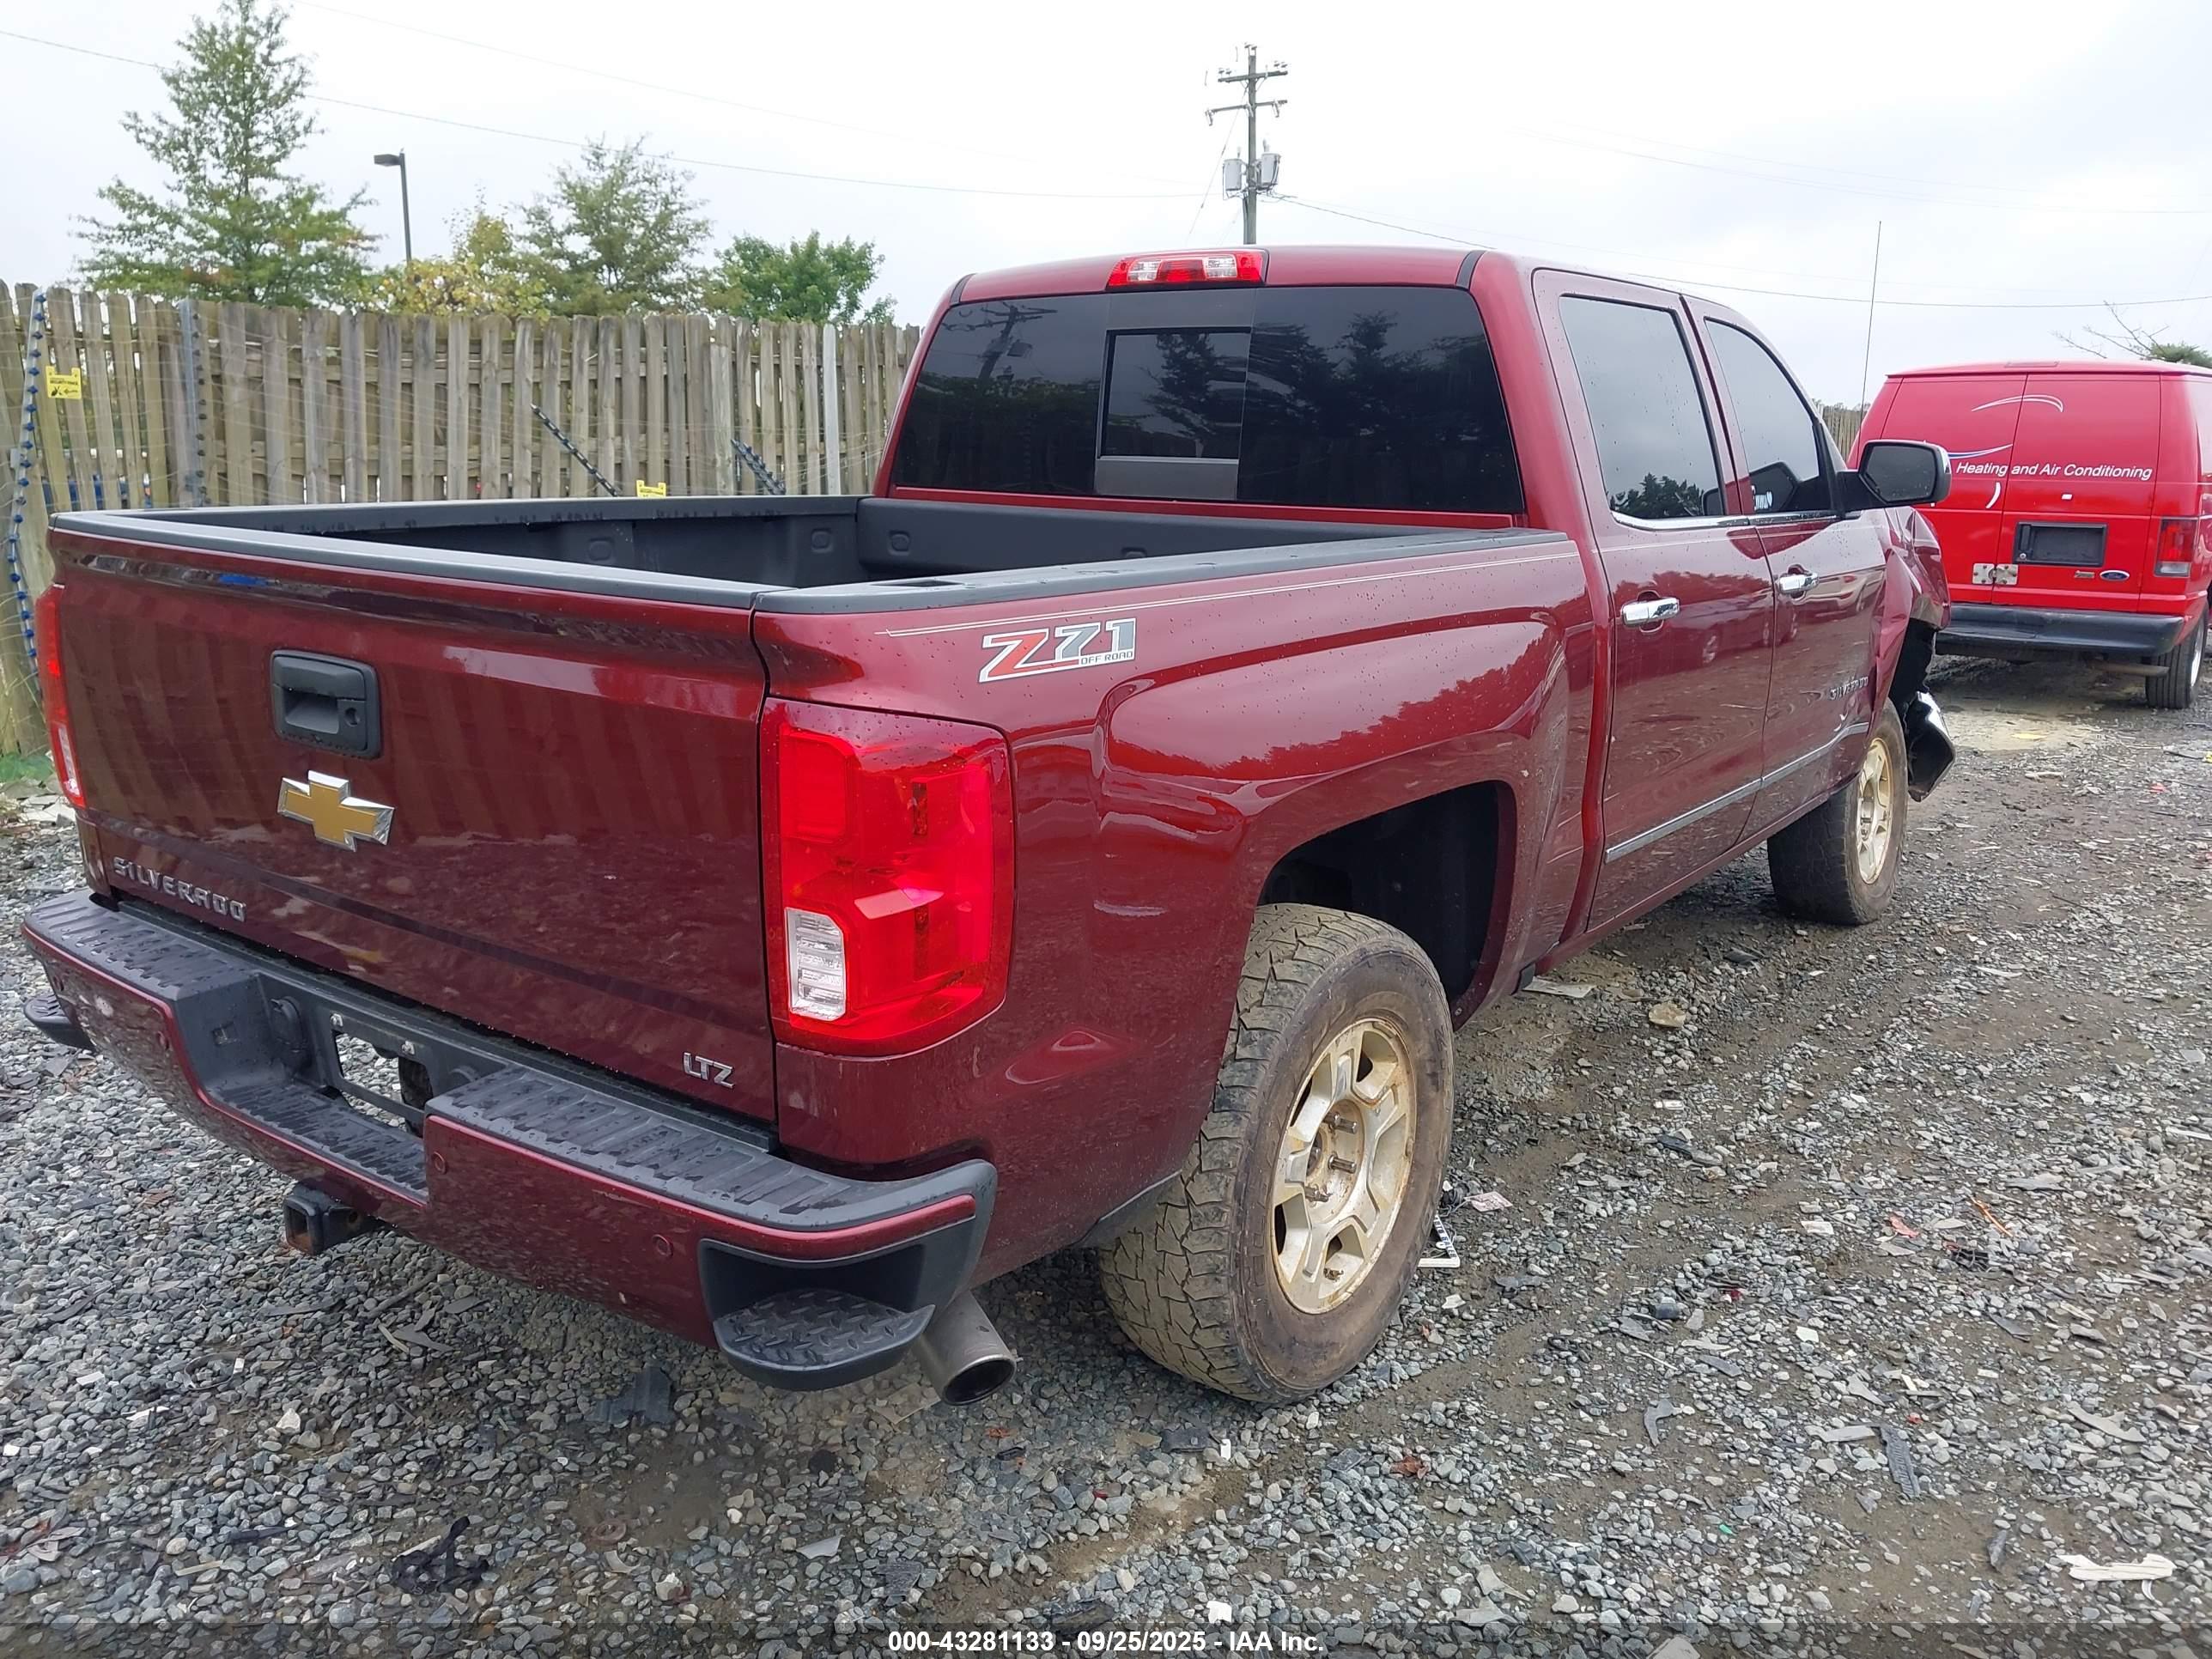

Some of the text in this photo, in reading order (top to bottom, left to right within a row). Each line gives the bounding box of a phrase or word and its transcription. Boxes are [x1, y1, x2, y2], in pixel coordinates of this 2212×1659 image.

[1956, 462, 2153, 480] Heating and Air Conditioning
[978, 617, 1137, 684] Z71
[1080, 650, 1133, 665] OFF ROAD
[112, 856, 246, 922] SILVERADO
[683, 1052, 735, 1089] LTZ
